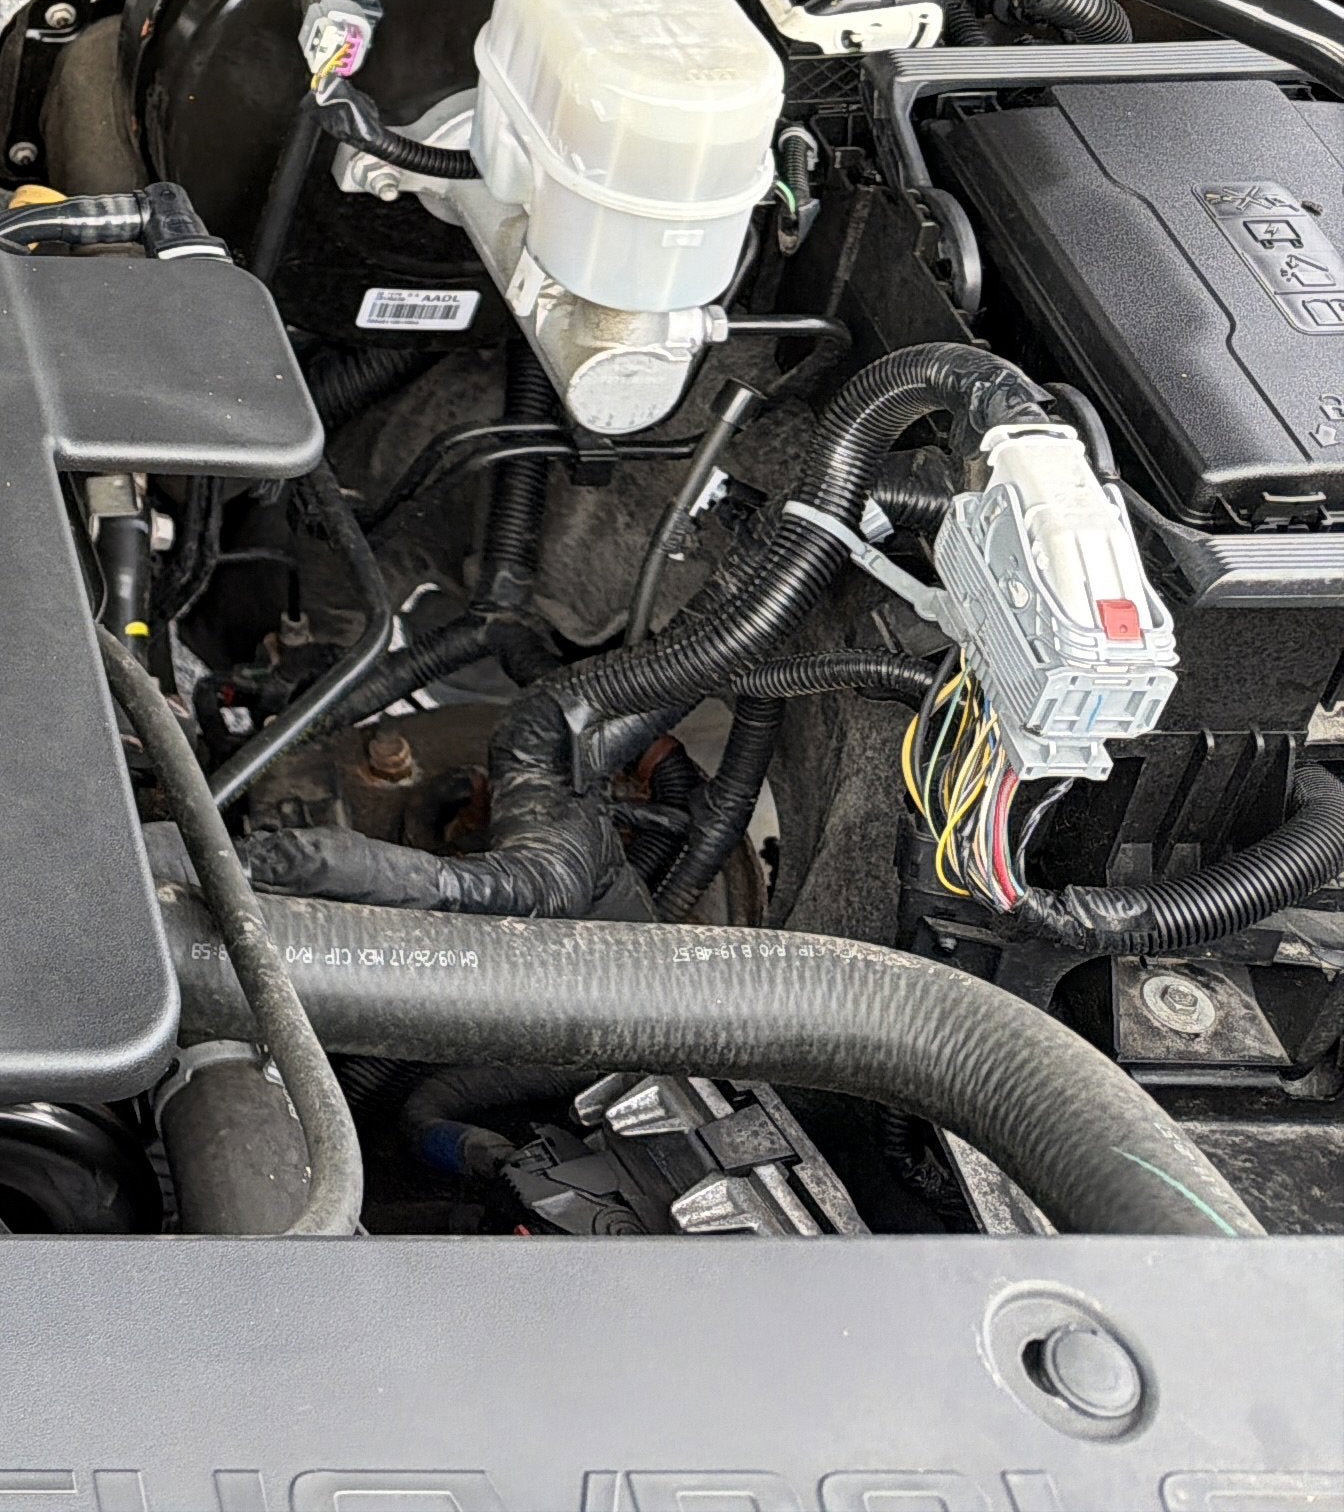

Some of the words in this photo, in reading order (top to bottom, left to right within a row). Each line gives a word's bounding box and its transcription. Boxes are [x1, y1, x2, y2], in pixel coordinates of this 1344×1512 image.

[421, 294, 461, 303] AADL
[325, 946, 352, 963] CIP
[359, 948, 385, 963] MEX
[390, 948, 456, 967] 09/26/17
[461, 950, 479, 968] GM
